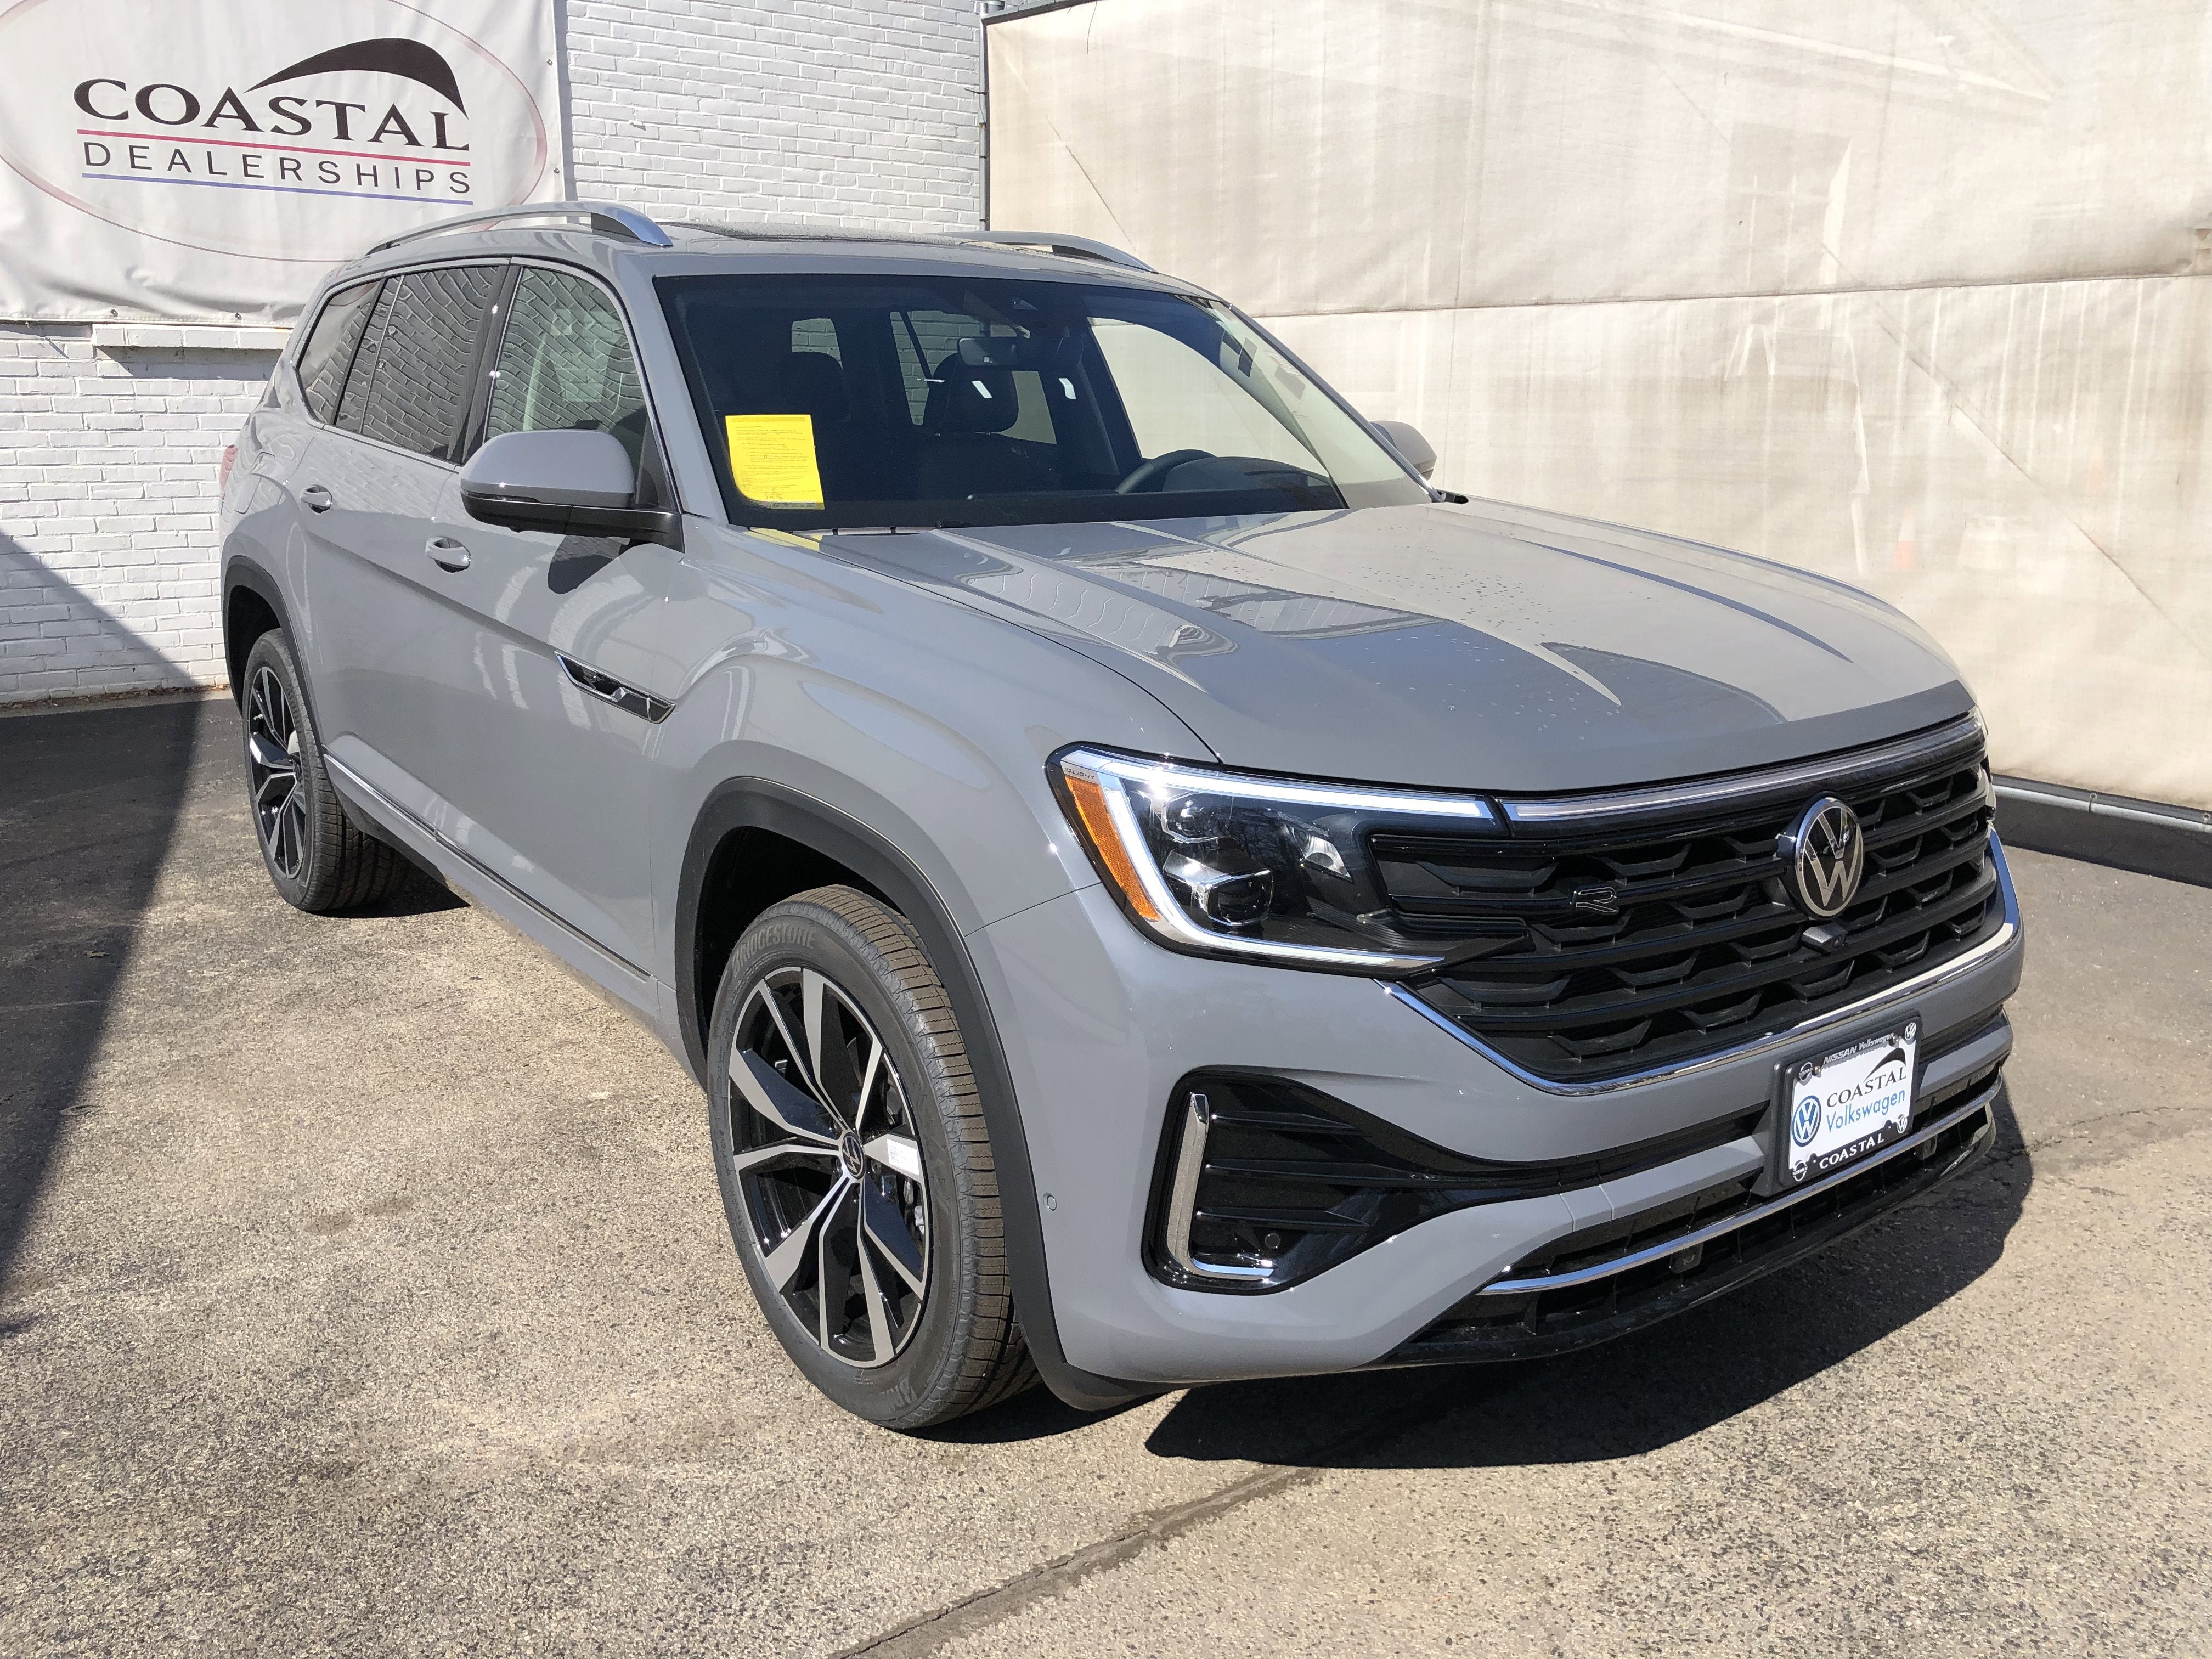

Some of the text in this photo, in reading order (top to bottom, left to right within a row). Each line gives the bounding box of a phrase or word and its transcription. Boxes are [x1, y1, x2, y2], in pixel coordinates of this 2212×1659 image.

[74, 78, 470, 151] COASTAL
[84, 142, 471, 194] DEALERSHIPS
[1823, 1032, 1894, 1065] NISSAN Volkswagen
[1826, 1066, 1907, 1108] COASTAL
[1826, 1090, 1905, 1133] Volkswagen
[1819, 1133, 1884, 1169] COASTAL
